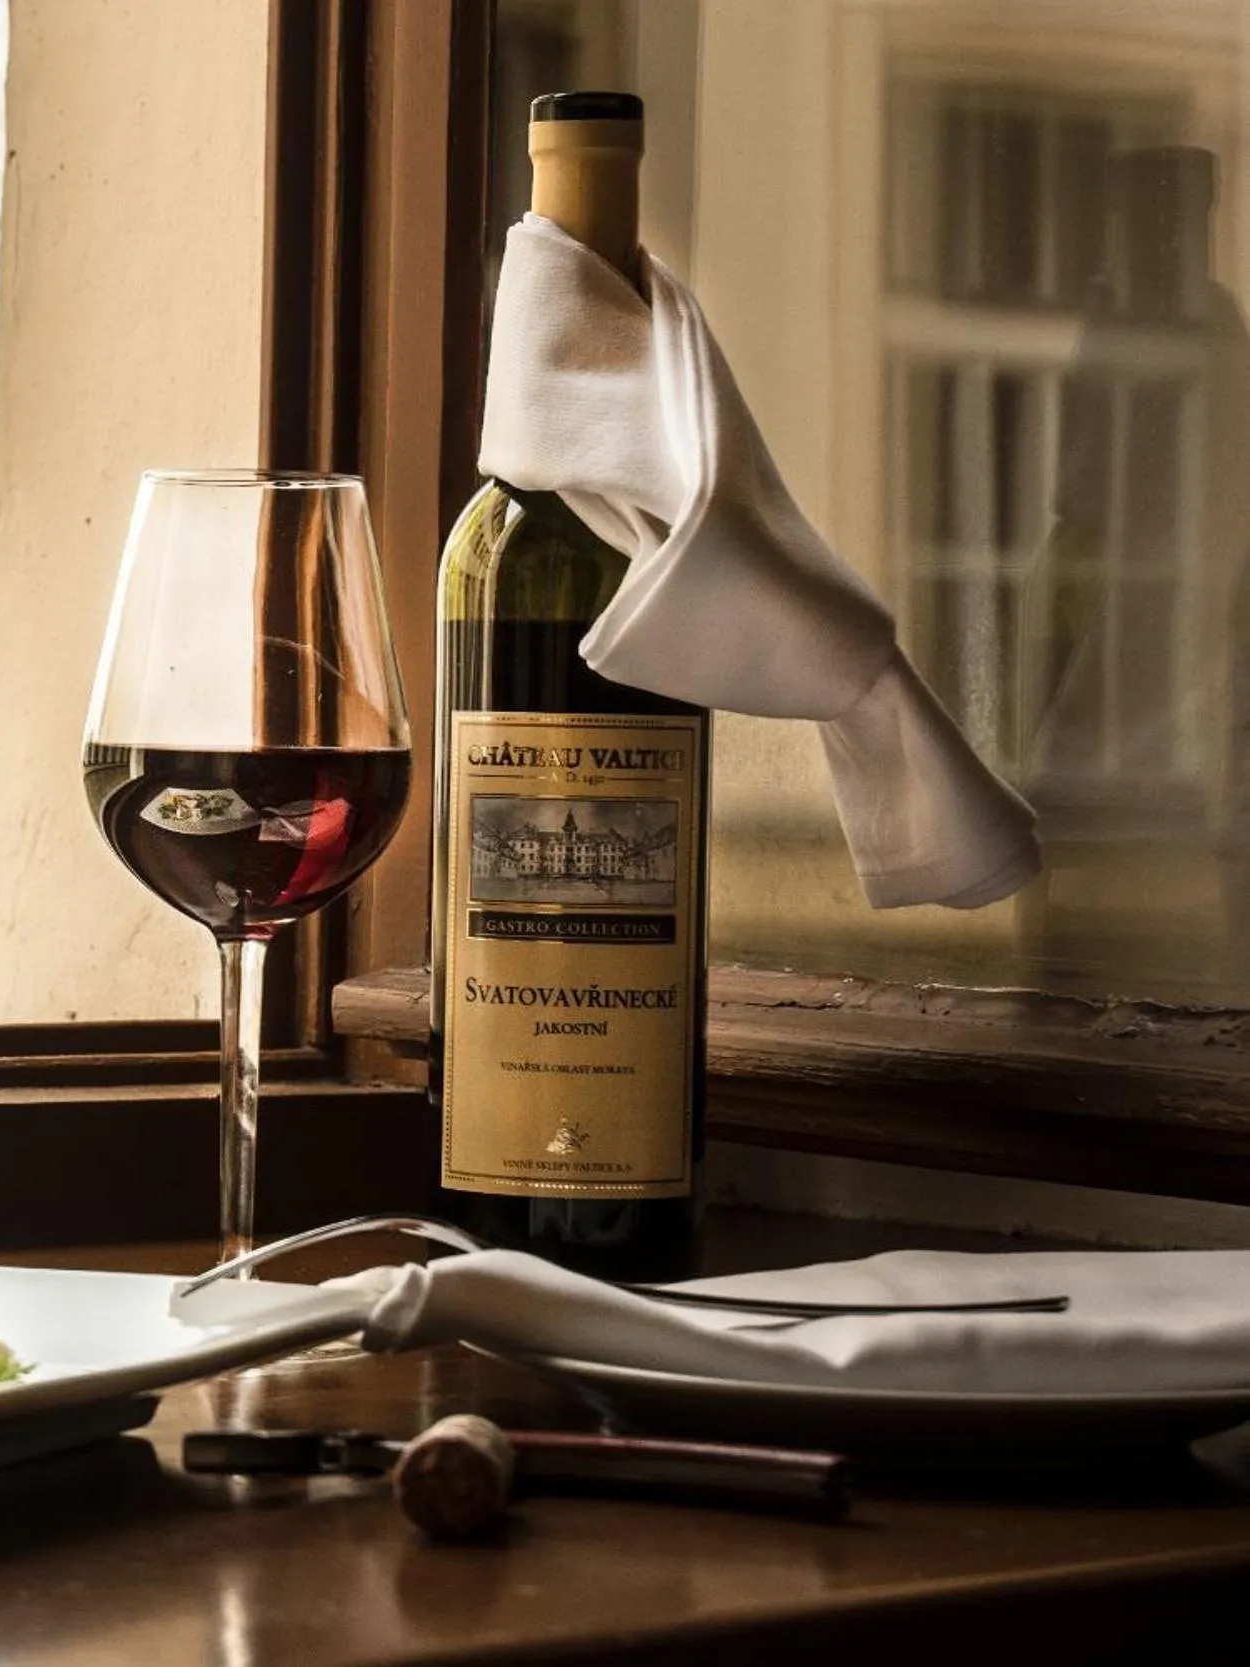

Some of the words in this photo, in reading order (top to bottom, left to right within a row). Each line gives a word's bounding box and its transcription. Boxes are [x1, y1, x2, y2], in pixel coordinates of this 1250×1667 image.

[467, 741, 583, 769] CHÂTEAU
[486, 918, 549, 934] GASTRO
[556, 921, 661, 936] COLLECTION
[465, 976, 678, 1009] SVATOVAVŘINECKÉ
[534, 1020, 608, 1037] JAKOSTNÍ
